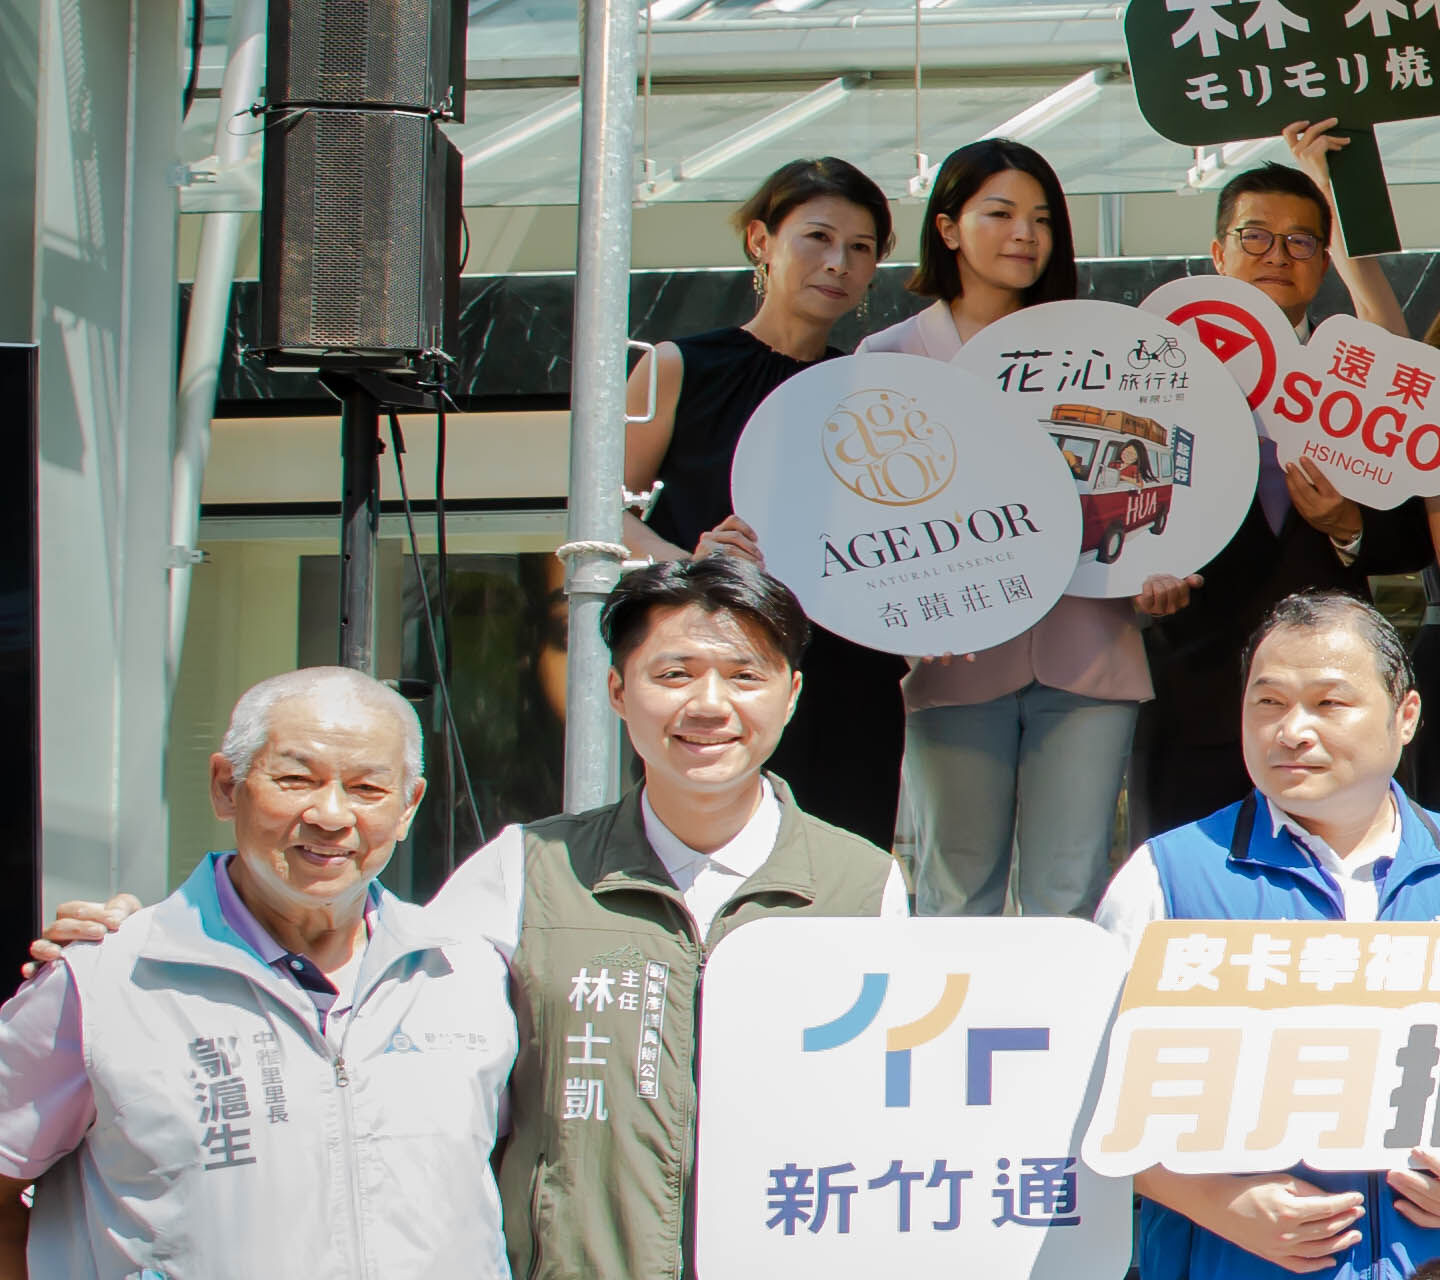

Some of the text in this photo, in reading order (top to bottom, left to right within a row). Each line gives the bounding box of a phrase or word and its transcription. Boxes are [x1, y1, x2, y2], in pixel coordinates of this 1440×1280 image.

[997, 349, 1112, 392] 花沁
[1118, 371, 1190, 392] 旅行社
[1330, 339, 1436, 411] 遠東
[1302, 439, 1394, 486] HSINCHU
[1126, 489, 1158, 526] HUA
[876, 574, 1034, 630] 奇蹟莊園
[618, 970, 640, 1011] 主任
[563, 966, 616, 1121] 林士凱
[766, 1157, 1081, 1236] 新竹通
